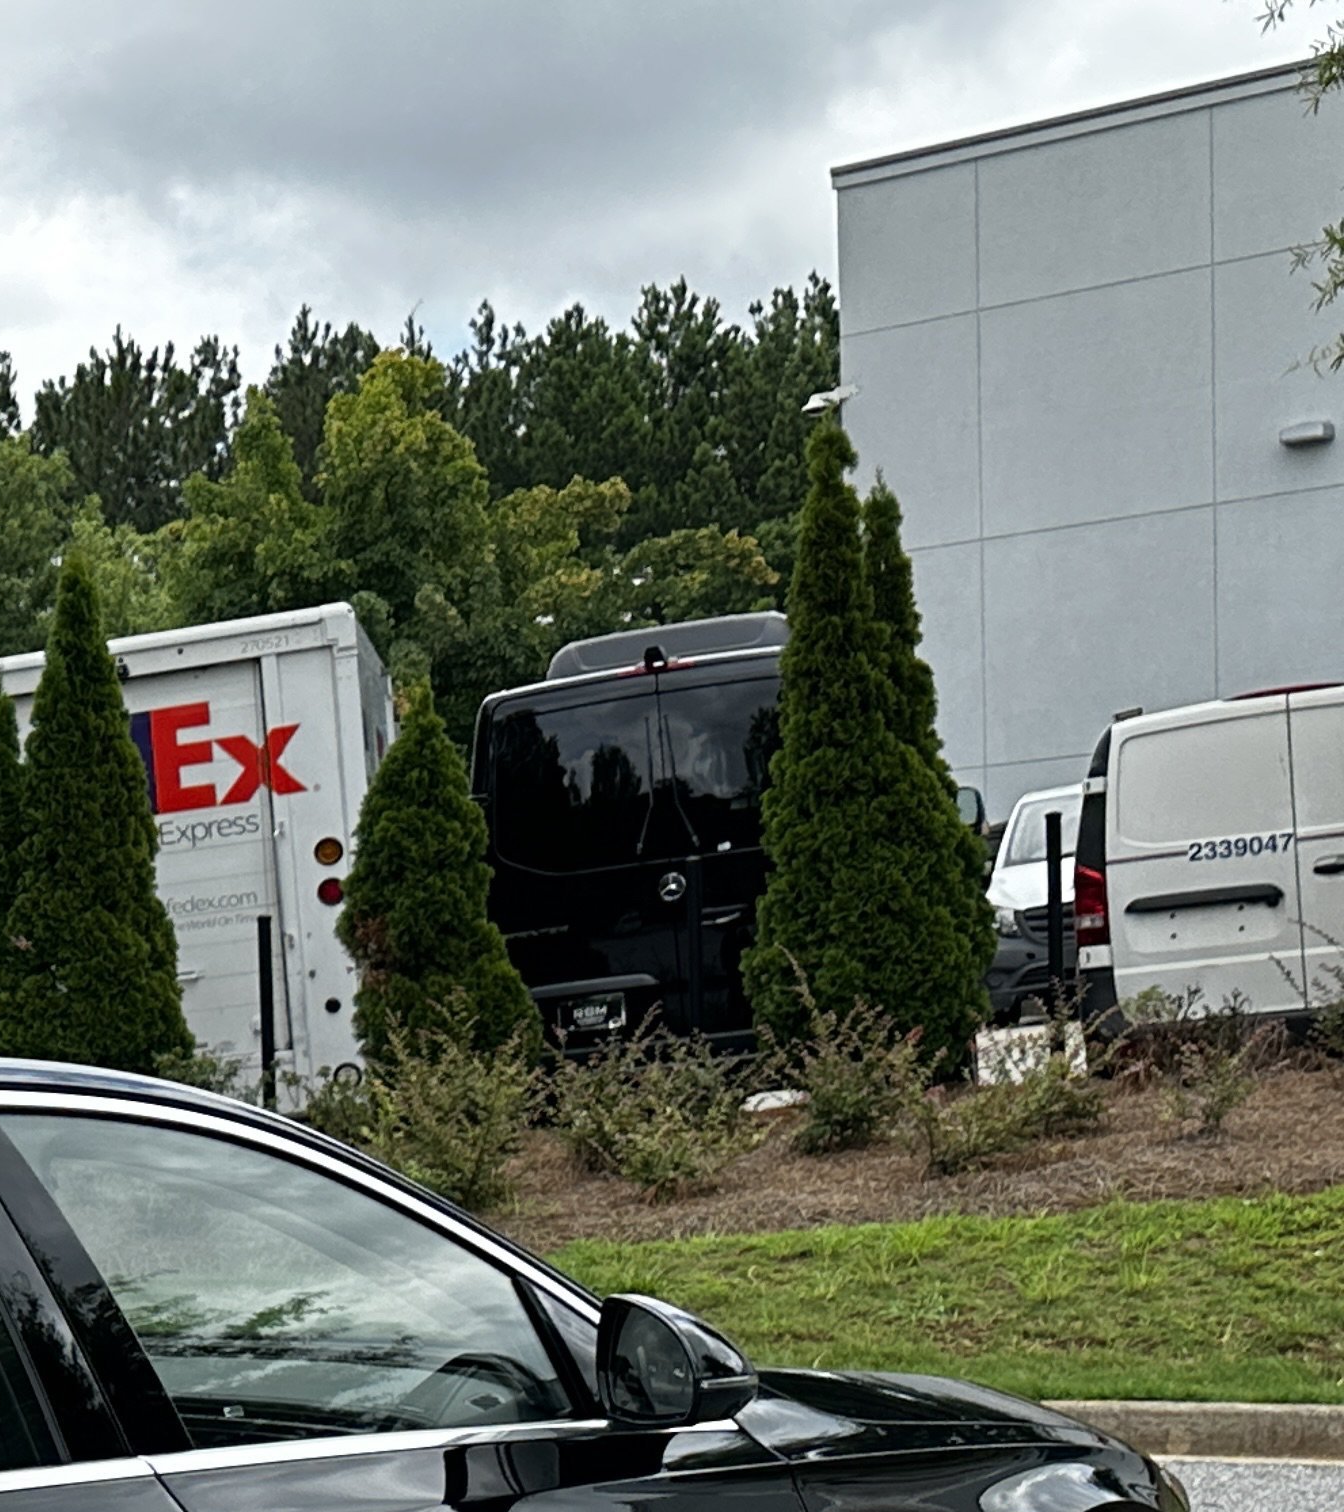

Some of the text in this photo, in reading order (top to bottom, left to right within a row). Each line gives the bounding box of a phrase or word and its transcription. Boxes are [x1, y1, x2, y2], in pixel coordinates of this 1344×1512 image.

[159, 814, 260, 849] Express
[1188, 832, 1293, 862] 2339047
[166, 890, 259, 915] fedex.com
